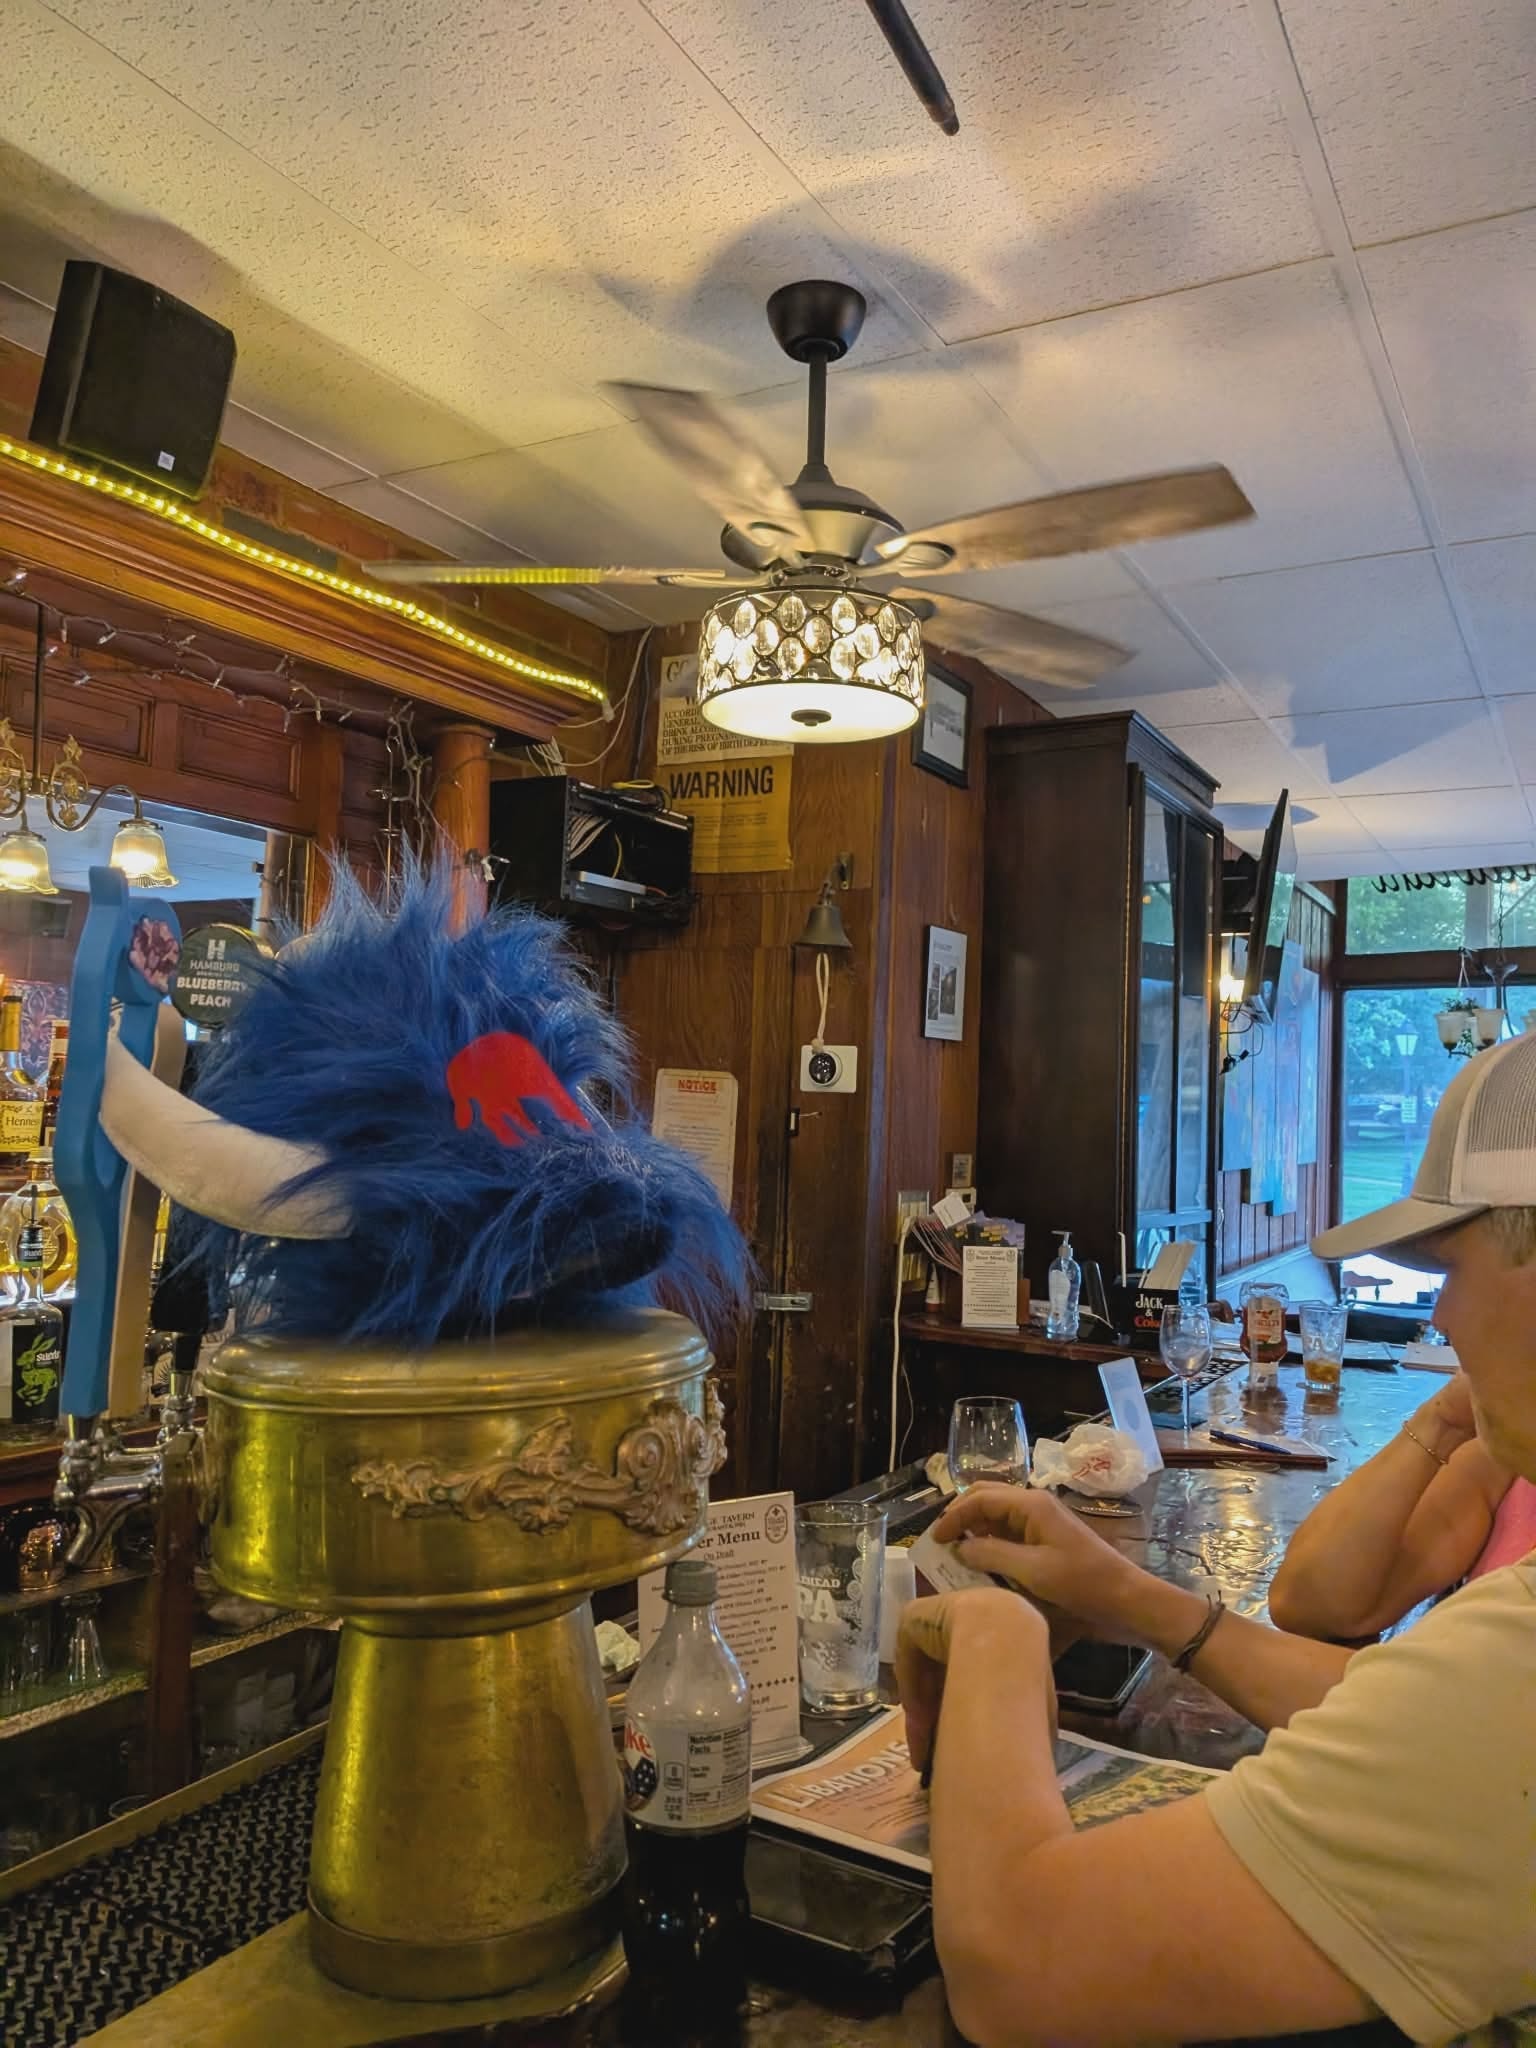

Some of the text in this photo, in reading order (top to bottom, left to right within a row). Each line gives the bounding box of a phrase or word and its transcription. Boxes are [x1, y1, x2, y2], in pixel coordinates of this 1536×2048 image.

[670, 765, 774, 799] WARNING
[177, 977, 248, 992] BLUEBERRY
[190, 993, 232, 1008] PEACH
[678, 1079, 717, 1091] NOTICE
[1135, 1293, 1164, 1309] JACK
[1145, 1308, 1153, 1317] &
[722, 1512, 755, 1524] TAVERN
[717, 1530, 761, 1546] Menu
